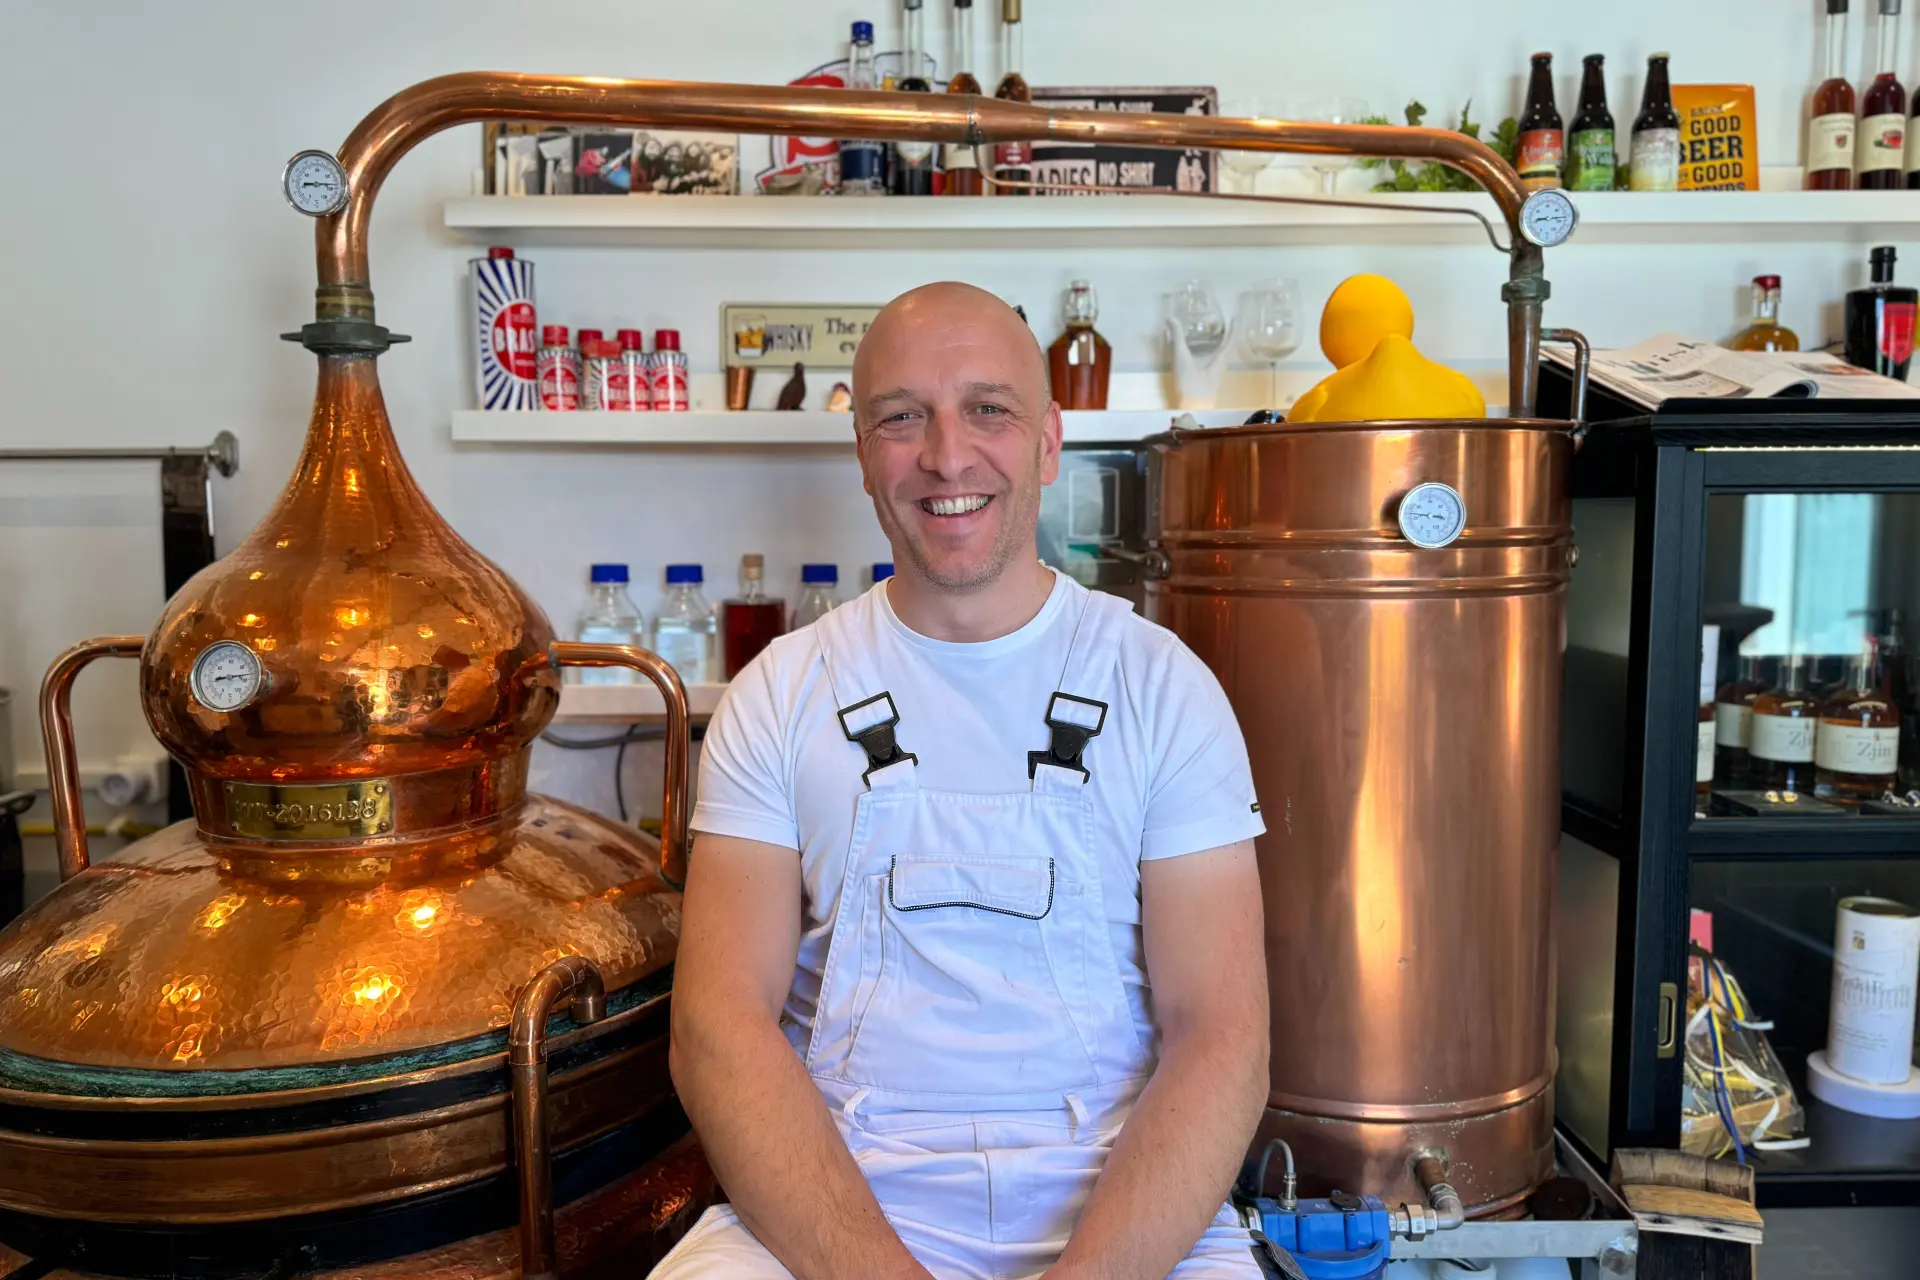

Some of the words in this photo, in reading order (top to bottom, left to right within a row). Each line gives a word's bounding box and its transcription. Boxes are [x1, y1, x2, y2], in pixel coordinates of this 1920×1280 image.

[1690, 115, 1741, 137] GOOD
[1034, 167, 1092, 195] ADIES
[1099, 162, 1118, 186] NO
[1120, 162, 1155, 186] SHIRT
[1692, 161, 1744, 183] GOOD
[825, 317, 856, 335] The
